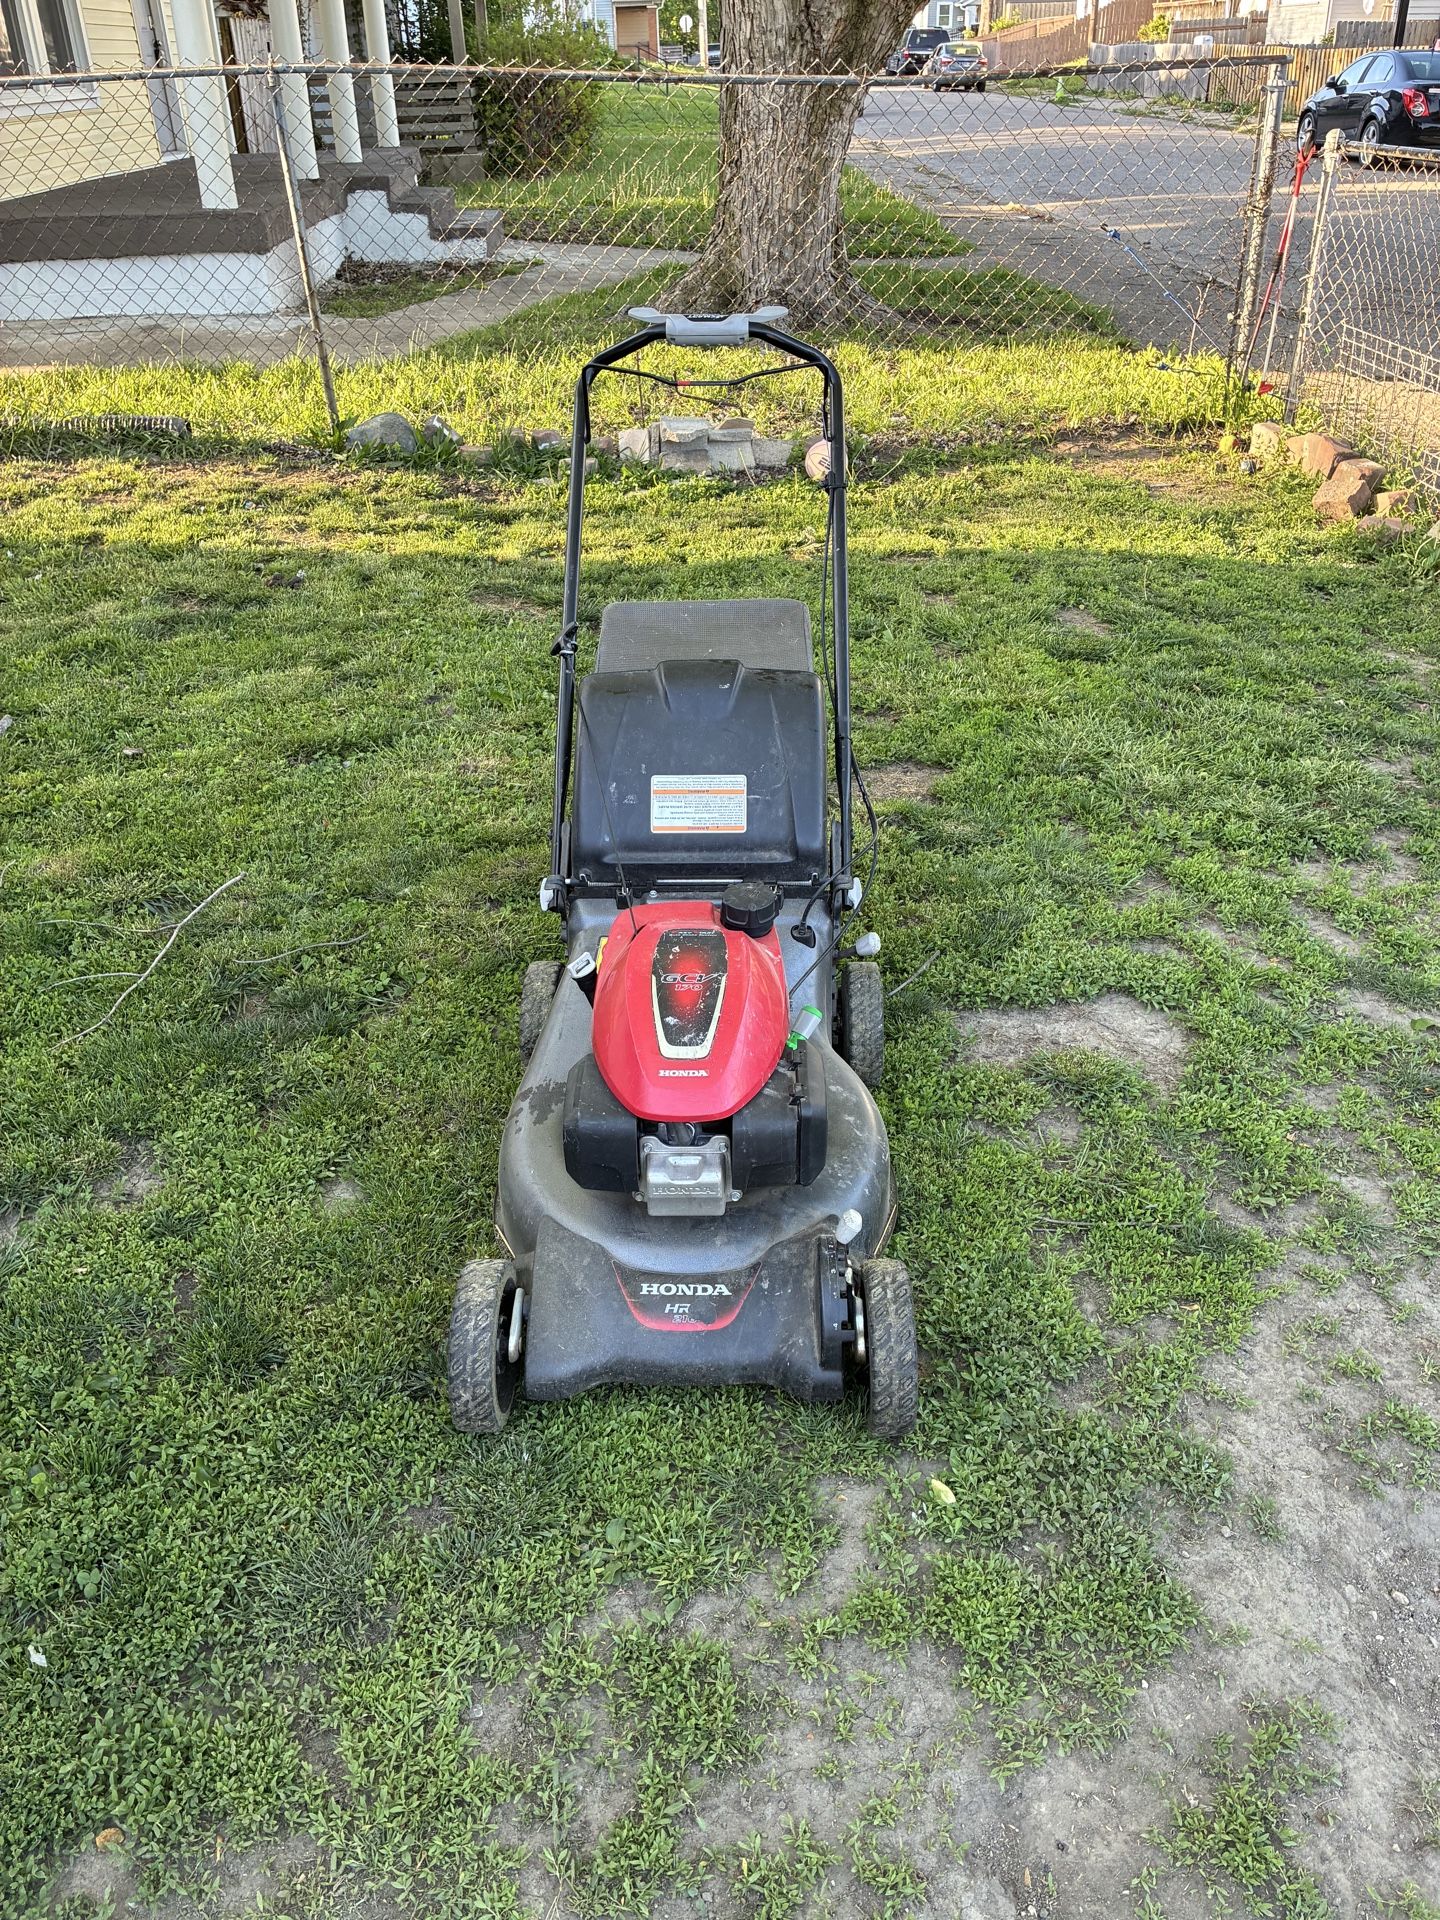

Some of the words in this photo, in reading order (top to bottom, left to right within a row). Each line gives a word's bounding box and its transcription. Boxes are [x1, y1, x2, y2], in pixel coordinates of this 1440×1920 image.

[658, 1069, 709, 1077] HONDA
[652, 1187, 717, 1195] HONDA
[640, 1283, 732, 1296] HONDA
